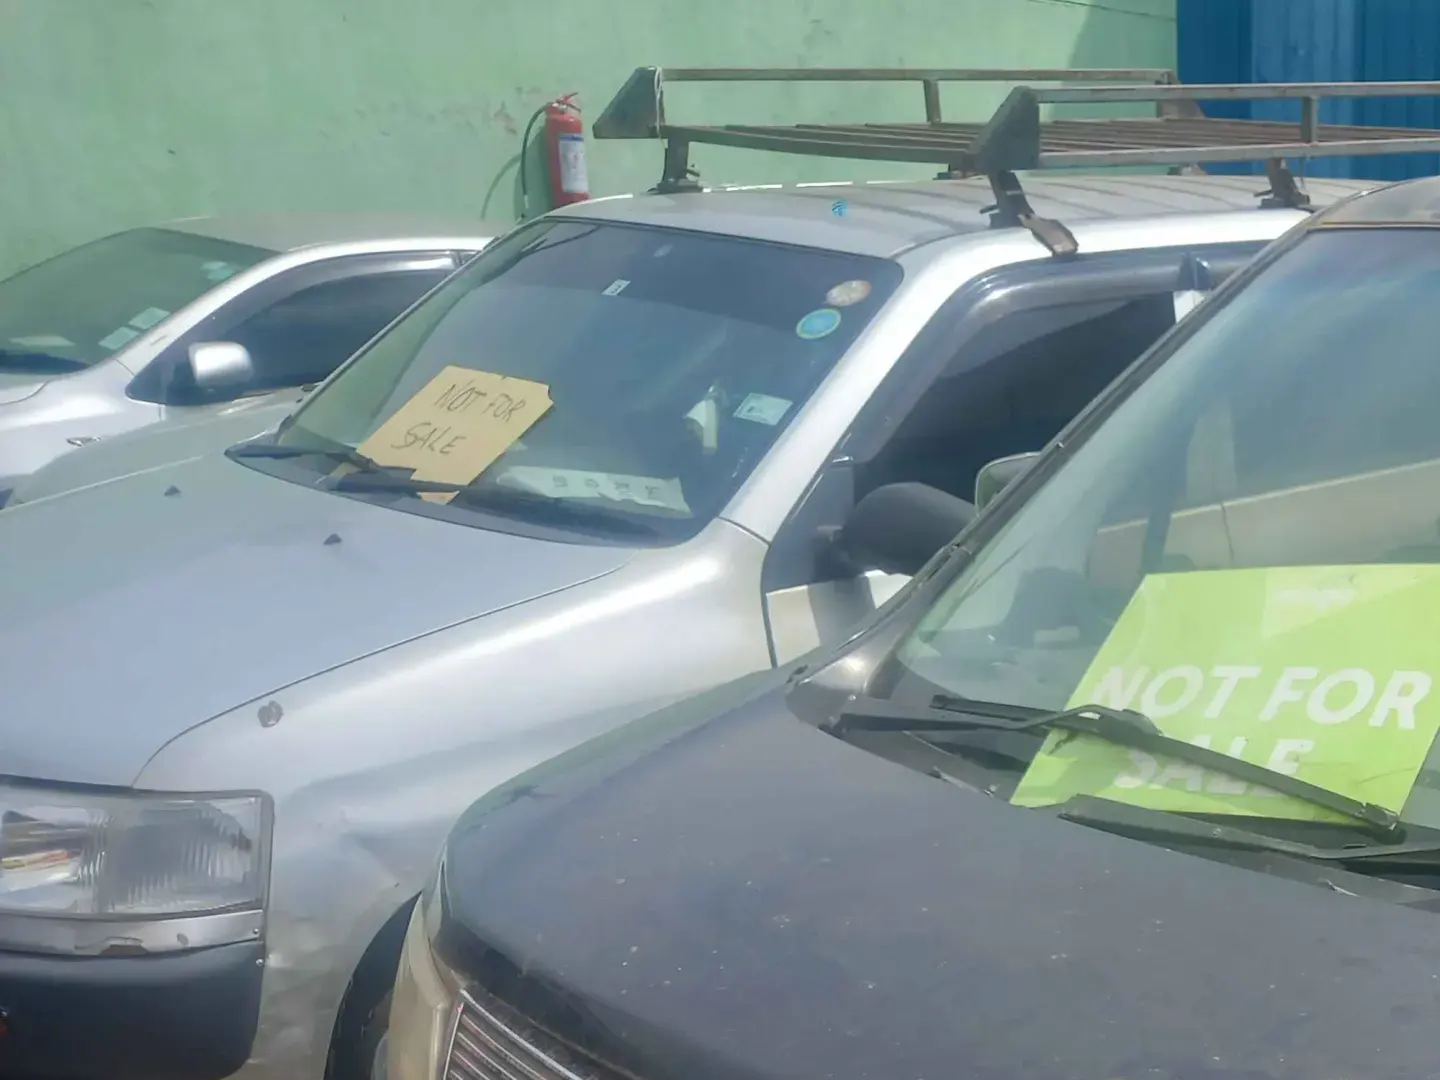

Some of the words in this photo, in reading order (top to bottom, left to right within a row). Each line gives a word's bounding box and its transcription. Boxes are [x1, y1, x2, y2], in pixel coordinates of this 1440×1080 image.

[434, 380, 486, 412] NOT
[480, 393, 526, 422] FOR
[390, 422, 466, 454] SALE
[1091, 665, 1260, 719] NOT
[1259, 667, 1432, 729] FOR
